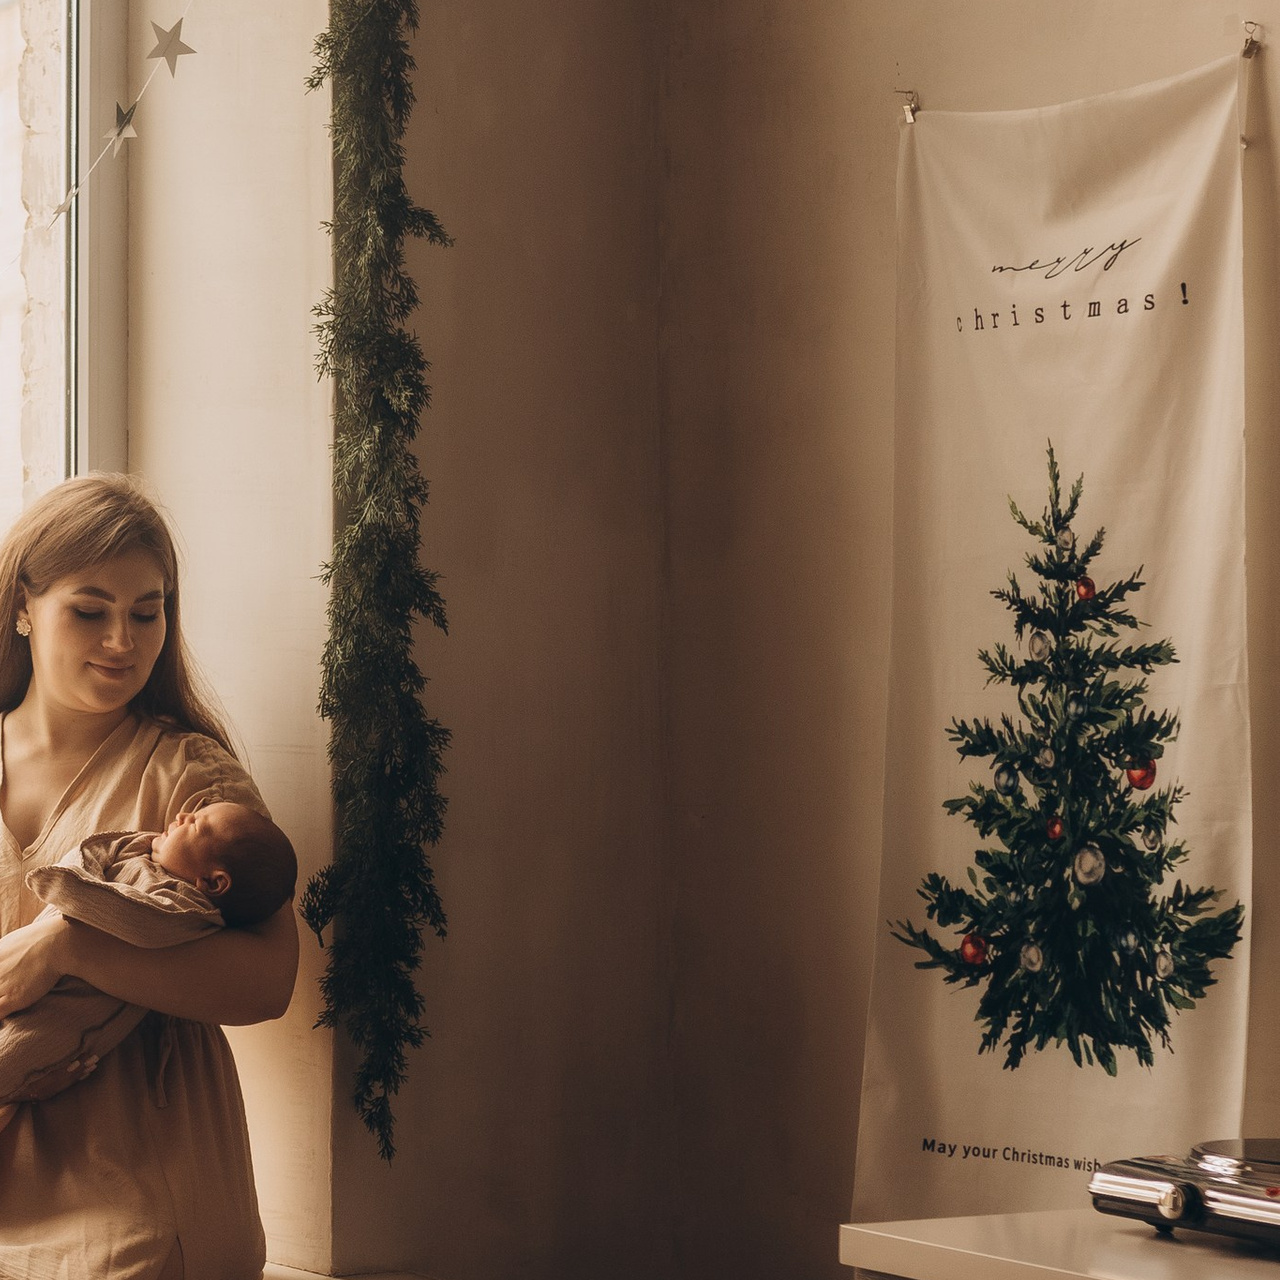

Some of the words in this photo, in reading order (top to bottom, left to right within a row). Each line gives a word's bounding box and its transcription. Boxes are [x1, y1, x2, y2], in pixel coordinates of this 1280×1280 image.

[991, 237, 1142, 279] merry
[922, 1138, 957, 1158] May
[962, 1145, 999, 1160] your
[1003, 1147, 1070, 1170] Christmas
